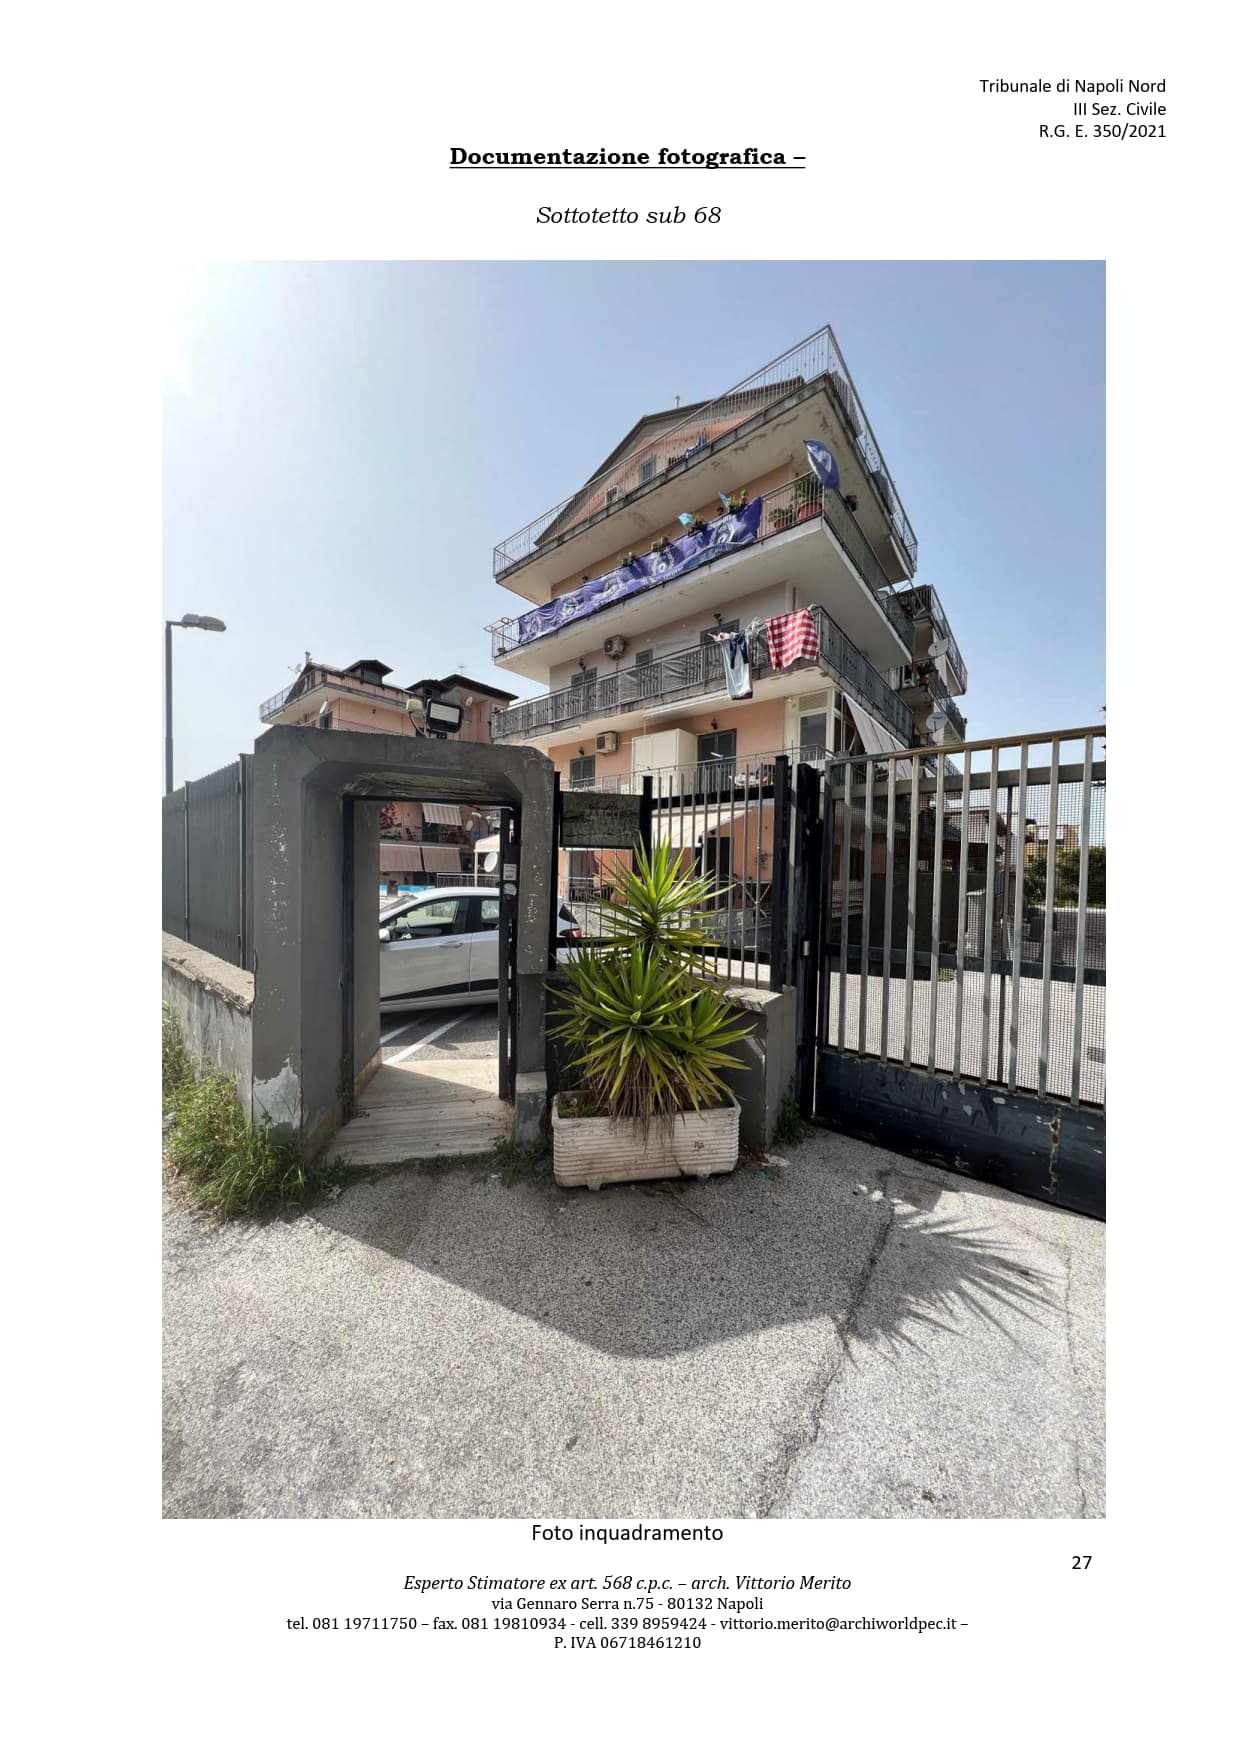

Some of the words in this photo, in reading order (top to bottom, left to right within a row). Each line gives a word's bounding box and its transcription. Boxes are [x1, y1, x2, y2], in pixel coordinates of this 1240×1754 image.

[979, 79, 1051, 92] Tribunale
[1057, 79, 1069, 92] di
[1076, 79, 1123, 95] Napoli
[1129, 79, 1165, 92] Nord
[1074, 103, 1086, 115] III
[1092, 103, 1120, 115] Sez.
[1127, 102, 1166, 115] Civile
[1040, 125, 1069, 137] R.G.
[1076, 125, 1087, 137] E.
[1093, 123, 1166, 140] 350/2021
[450, 148, 649, 164] Documentazione
[658, 148, 786, 168] fotografica
[537, 207, 638, 223] Sottotetto
[646, 206, 686, 223] sub
[695, 207, 721, 223] 68
[533, 1525, 573, 1540] Foto
[580, 1524, 723, 1544] inquadramento
[1072, 1556, 1092, 1569] 27
[404, 1576, 463, 1593] Esperto
[467, 1576, 545, 1589] Stimatore
[550, 1580, 567, 1589] ex
[571, 1578, 597, 1589] art.
[603, 1575, 632, 1589] 568
[637, 1580, 672, 1593] c.p.c.
[692, 1576, 729, 1589] arch.
[736, 1576, 795, 1589] Vittorio
[800, 1576, 851, 1589] Merito
[491, 1598, 512, 1609] via
[517, 1598, 577, 1609] Gennaro
[582, 1598, 619, 1609] Serra
[624, 1597, 653, 1609] n.75
[668, 1598, 712, 1609] 80132
[717, 1597, 763, 1613] Napoli
[287, 1617, 308, 1629] tel.
[313, 1618, 339, 1629] 081
[345, 1617, 417, 1629] 19711750
[433, 1617, 457, 1629] fax.
[462, 1618, 488, 1629] 081
[494, 1618, 566, 1629] 19810934
[580, 1617, 607, 1629] cell.
[612, 1618, 638, 1629] 339
[643, 1617, 707, 1629] 8959424
[720, 1617, 957, 1633] vittorio.merito@archiworldpec.it
[554, 1637, 566, 1648] P.
[571, 1637, 596, 1648] IVA
[601, 1637, 701, 1648] 06718461210
